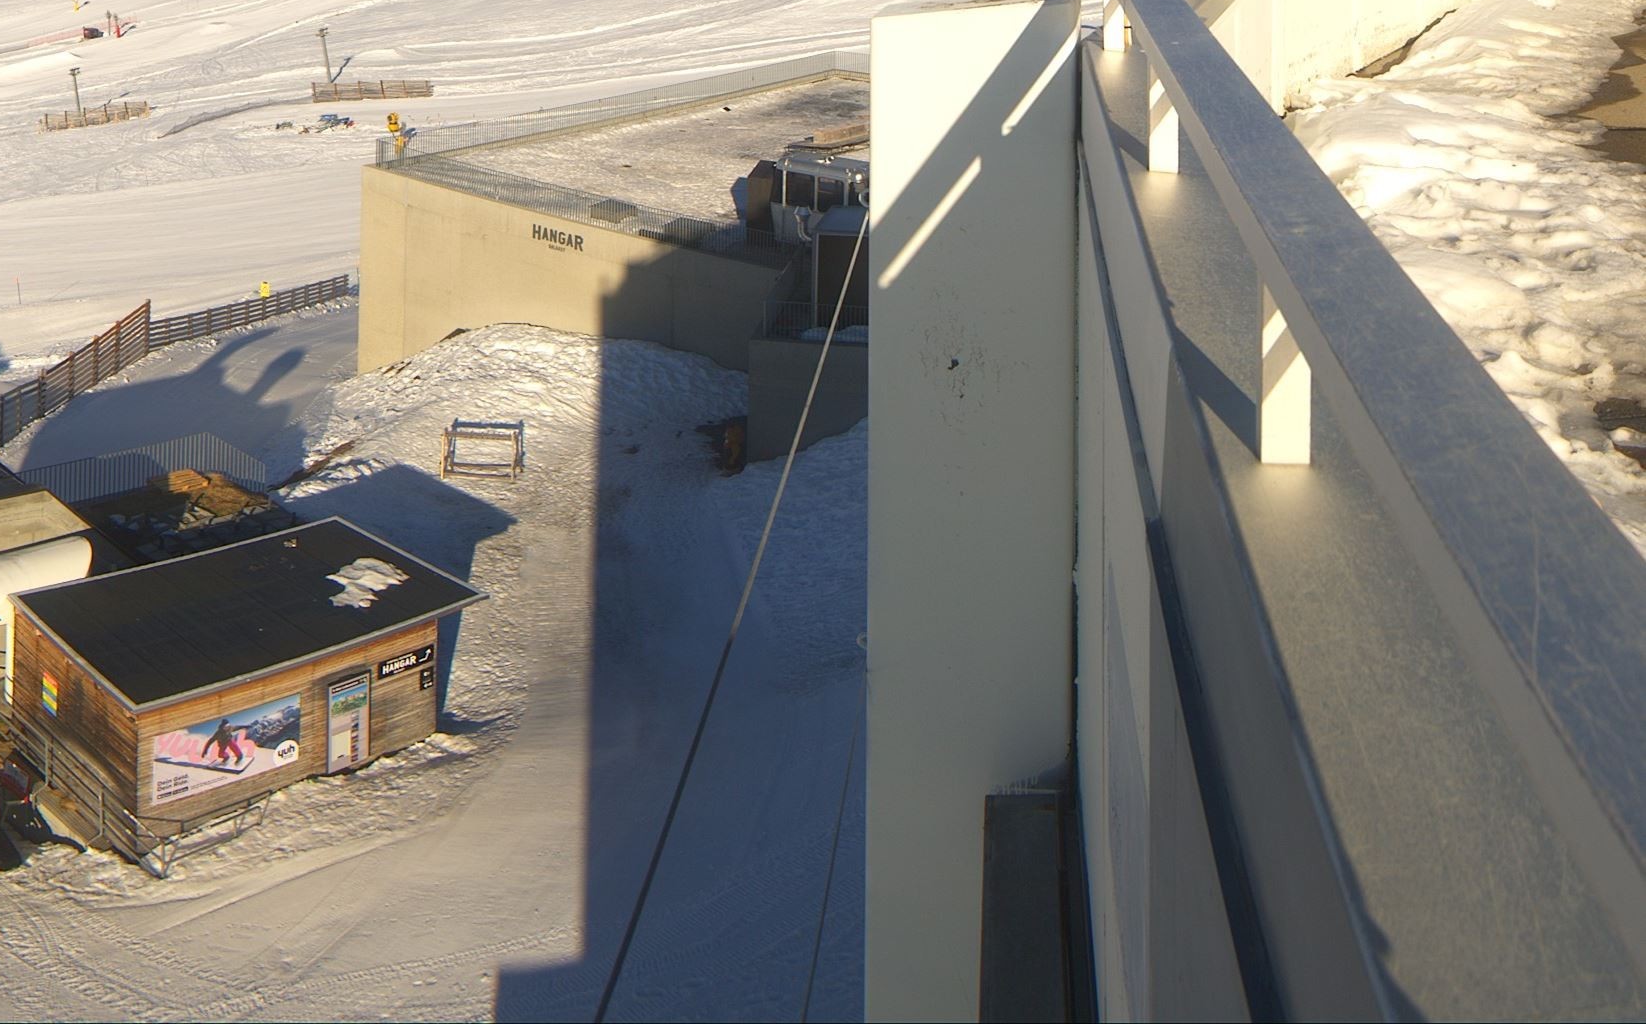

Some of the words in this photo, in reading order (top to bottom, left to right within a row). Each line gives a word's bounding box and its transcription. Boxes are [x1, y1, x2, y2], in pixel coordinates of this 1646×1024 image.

[532, 223, 584, 252] HANGAR
[382, 655, 417, 675] HANGAR
[277, 744, 295, 759] yuh
